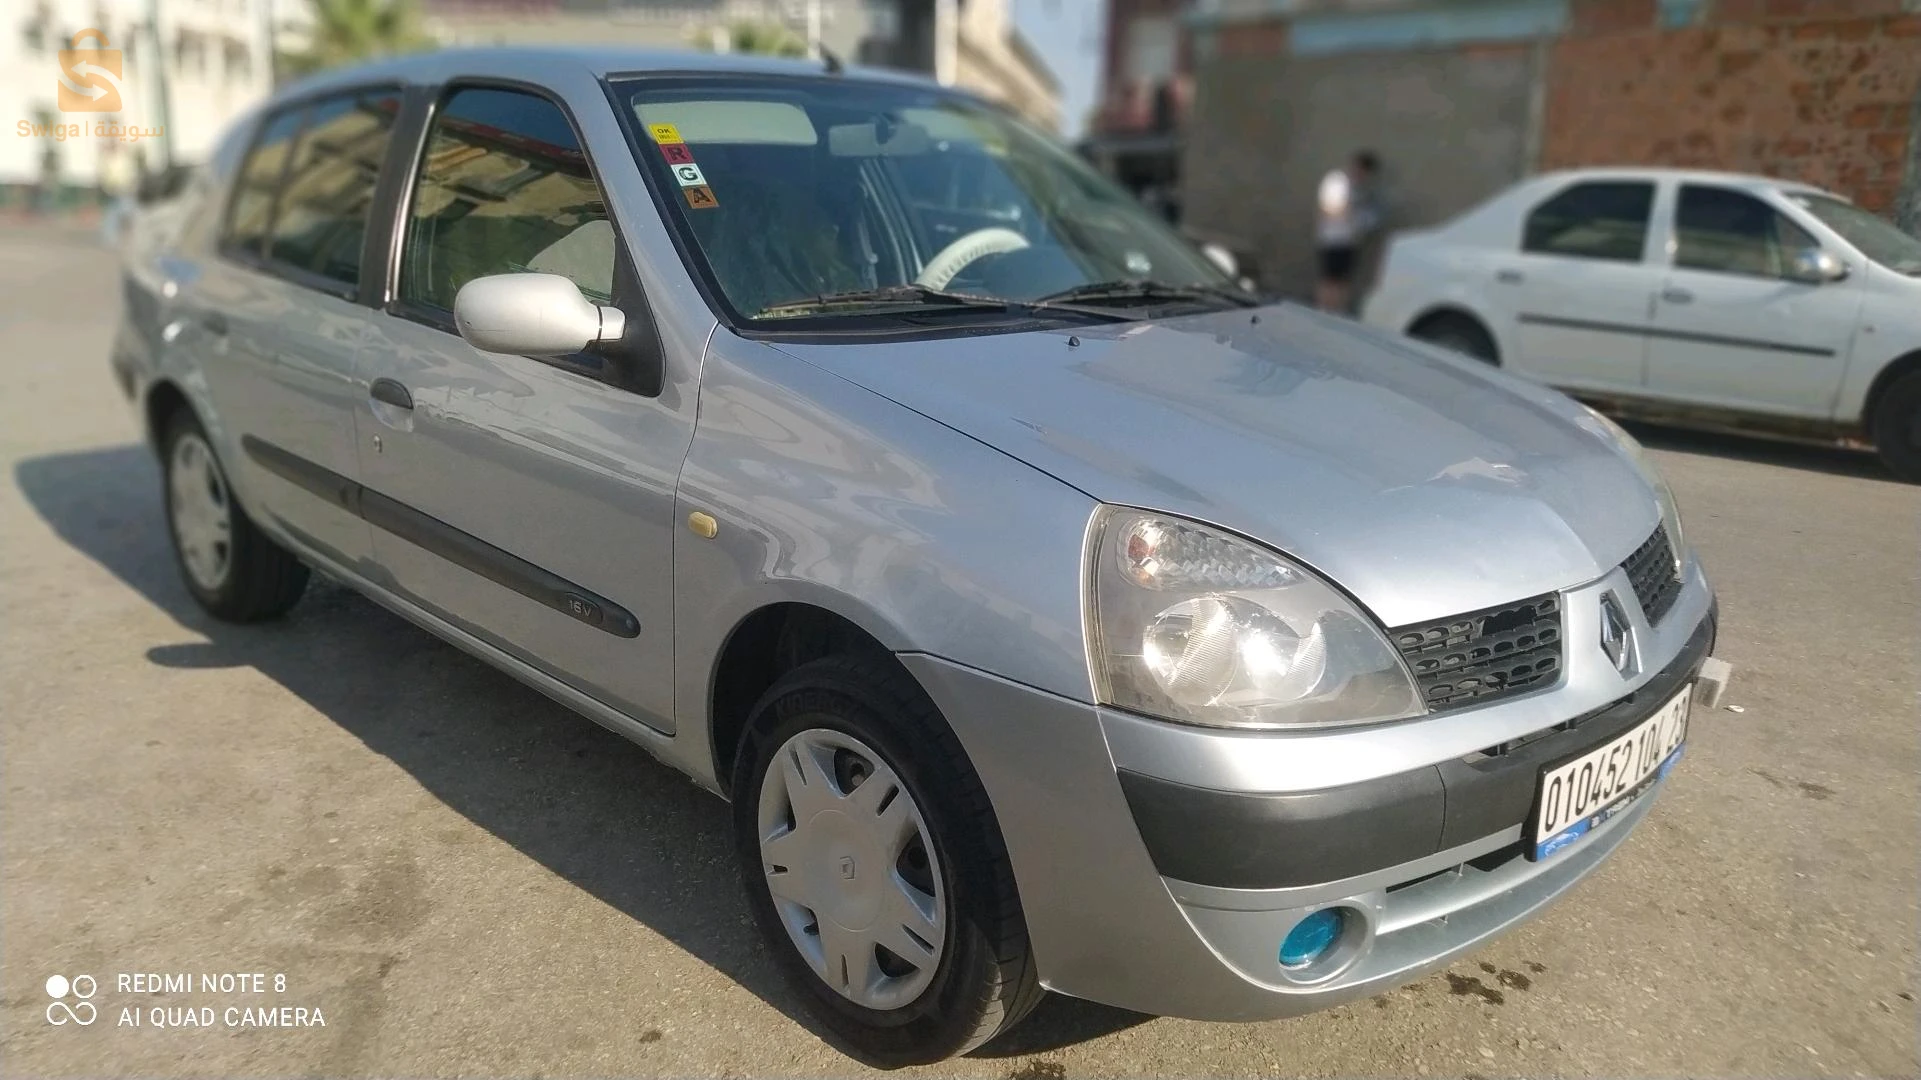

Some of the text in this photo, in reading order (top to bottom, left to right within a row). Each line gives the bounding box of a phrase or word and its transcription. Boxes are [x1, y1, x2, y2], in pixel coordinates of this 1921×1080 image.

[667, 148, 688, 160] R
[678, 167, 698, 180] G
[693, 188, 712, 203] A
[569, 600, 592, 617] 16V
[1544, 739, 1633, 832] 010452
